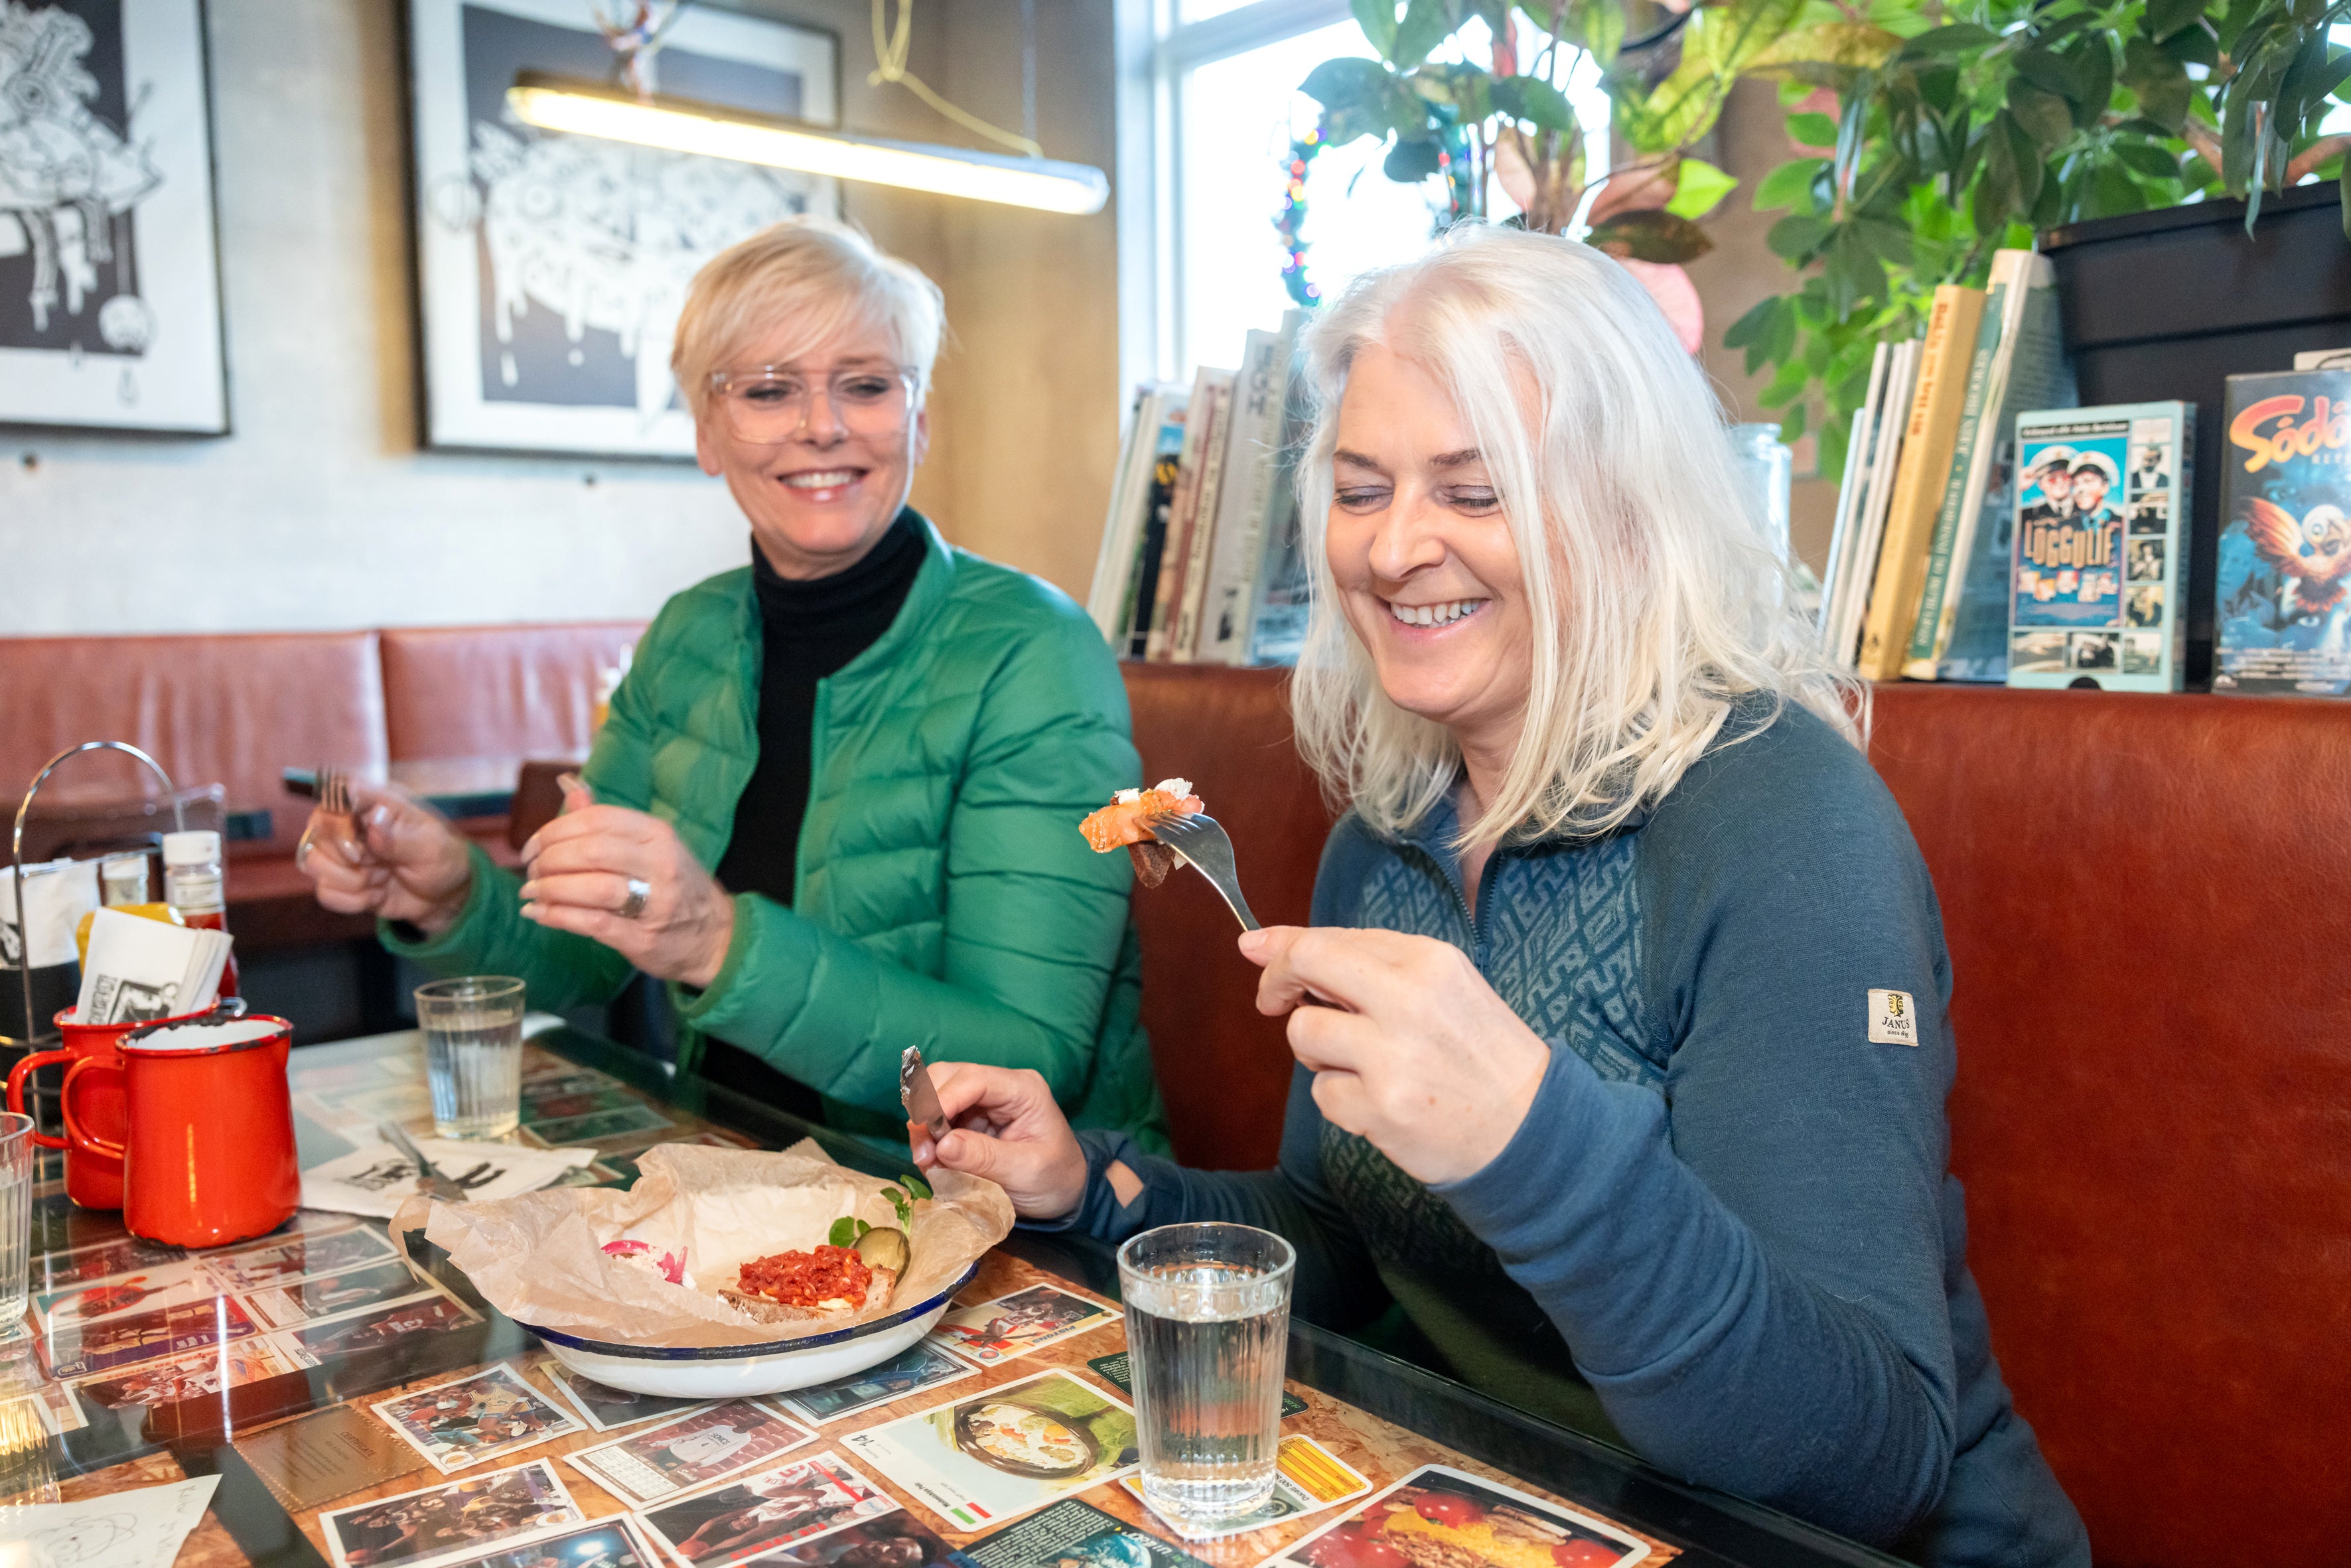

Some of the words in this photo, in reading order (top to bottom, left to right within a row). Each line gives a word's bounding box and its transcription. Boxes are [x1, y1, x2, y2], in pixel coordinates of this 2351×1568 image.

[1882, 1017, 1910, 1030] JANUS
[1032, 1324, 1076, 1344] PISTONS
[850, 1433, 868, 1447] 14
[1279, 1478, 1293, 1490] 500
[1291, 1486, 1310, 1502] Ducati
